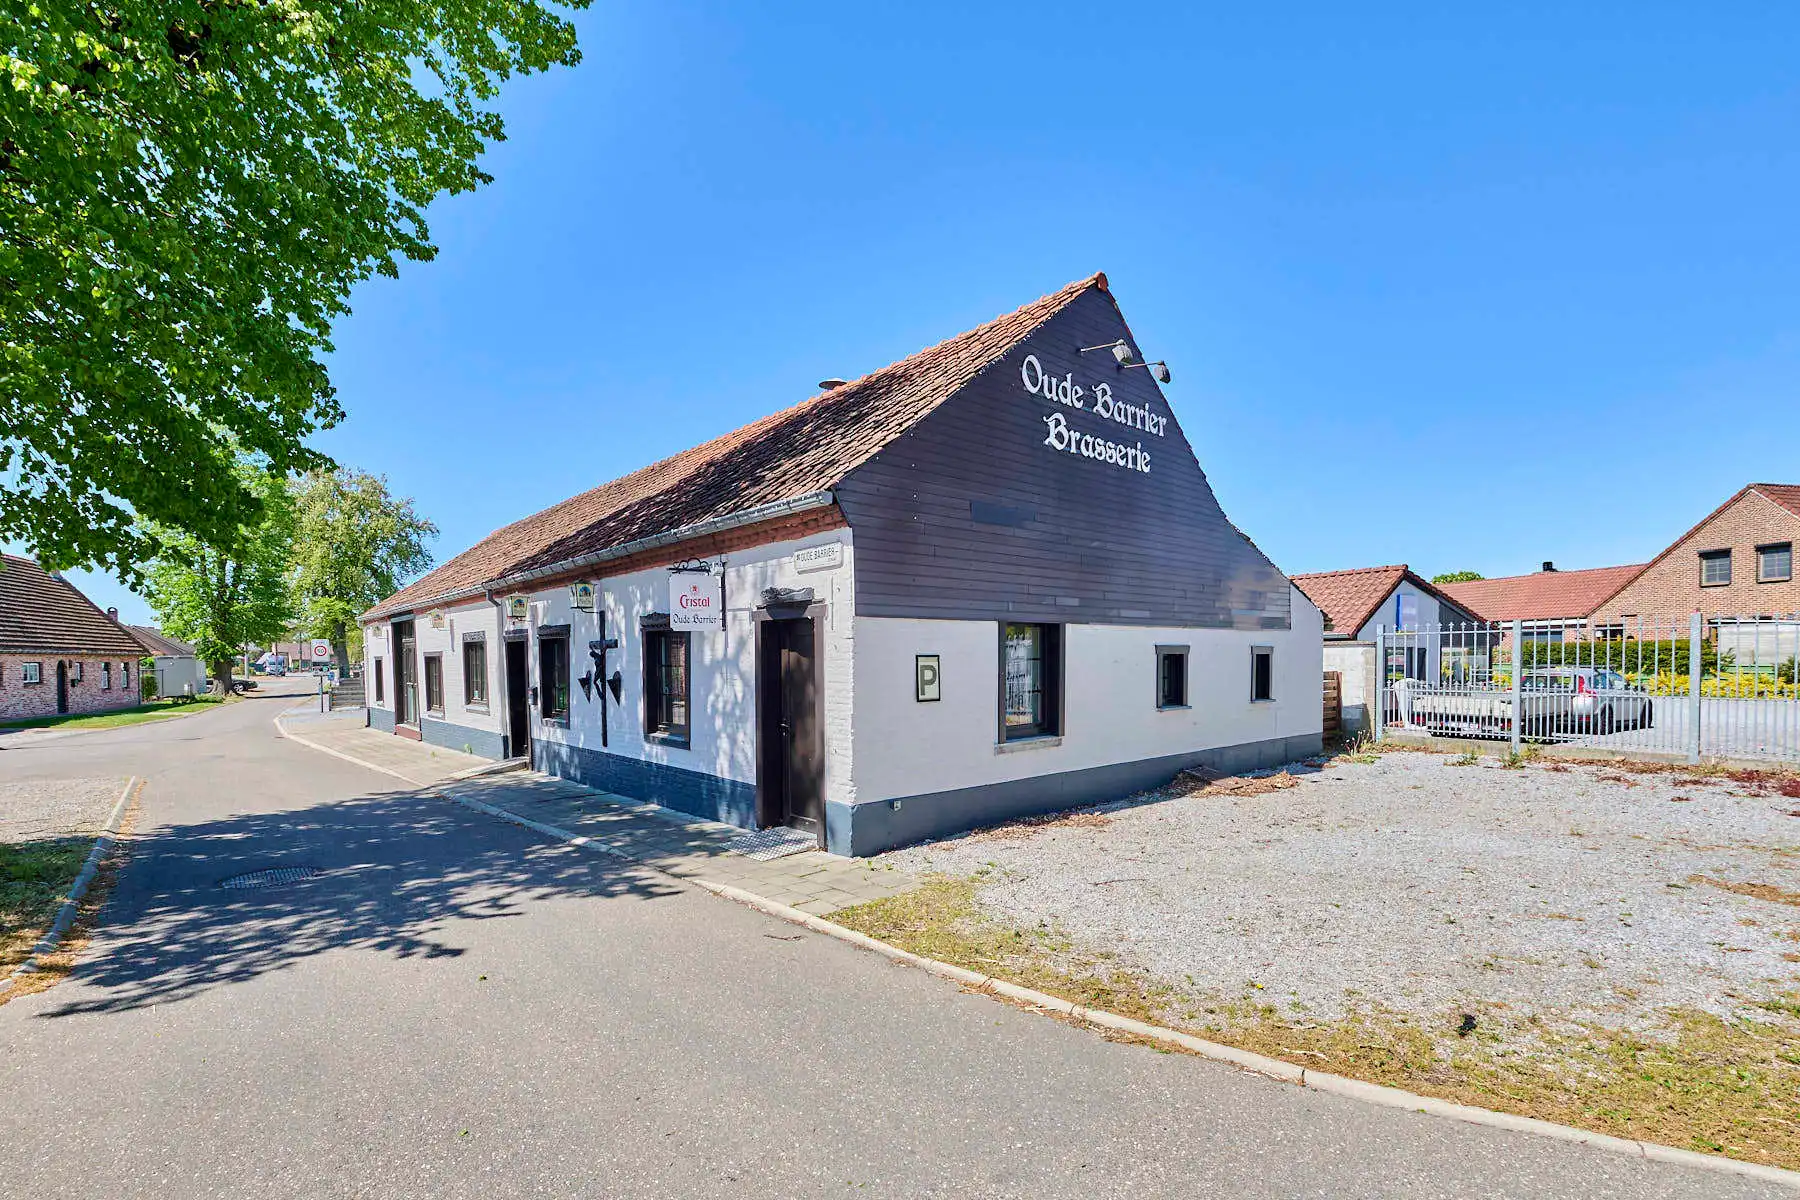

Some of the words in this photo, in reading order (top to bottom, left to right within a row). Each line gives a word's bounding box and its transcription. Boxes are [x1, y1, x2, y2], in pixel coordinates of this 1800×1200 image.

[1021, 354, 1084, 409] Oude
[1091, 382, 1168, 437] Barrier
[1042, 412, 1151, 473] Brasserie
[679, 594, 710, 609] Cristal
[920, 664, 938, 696] P
